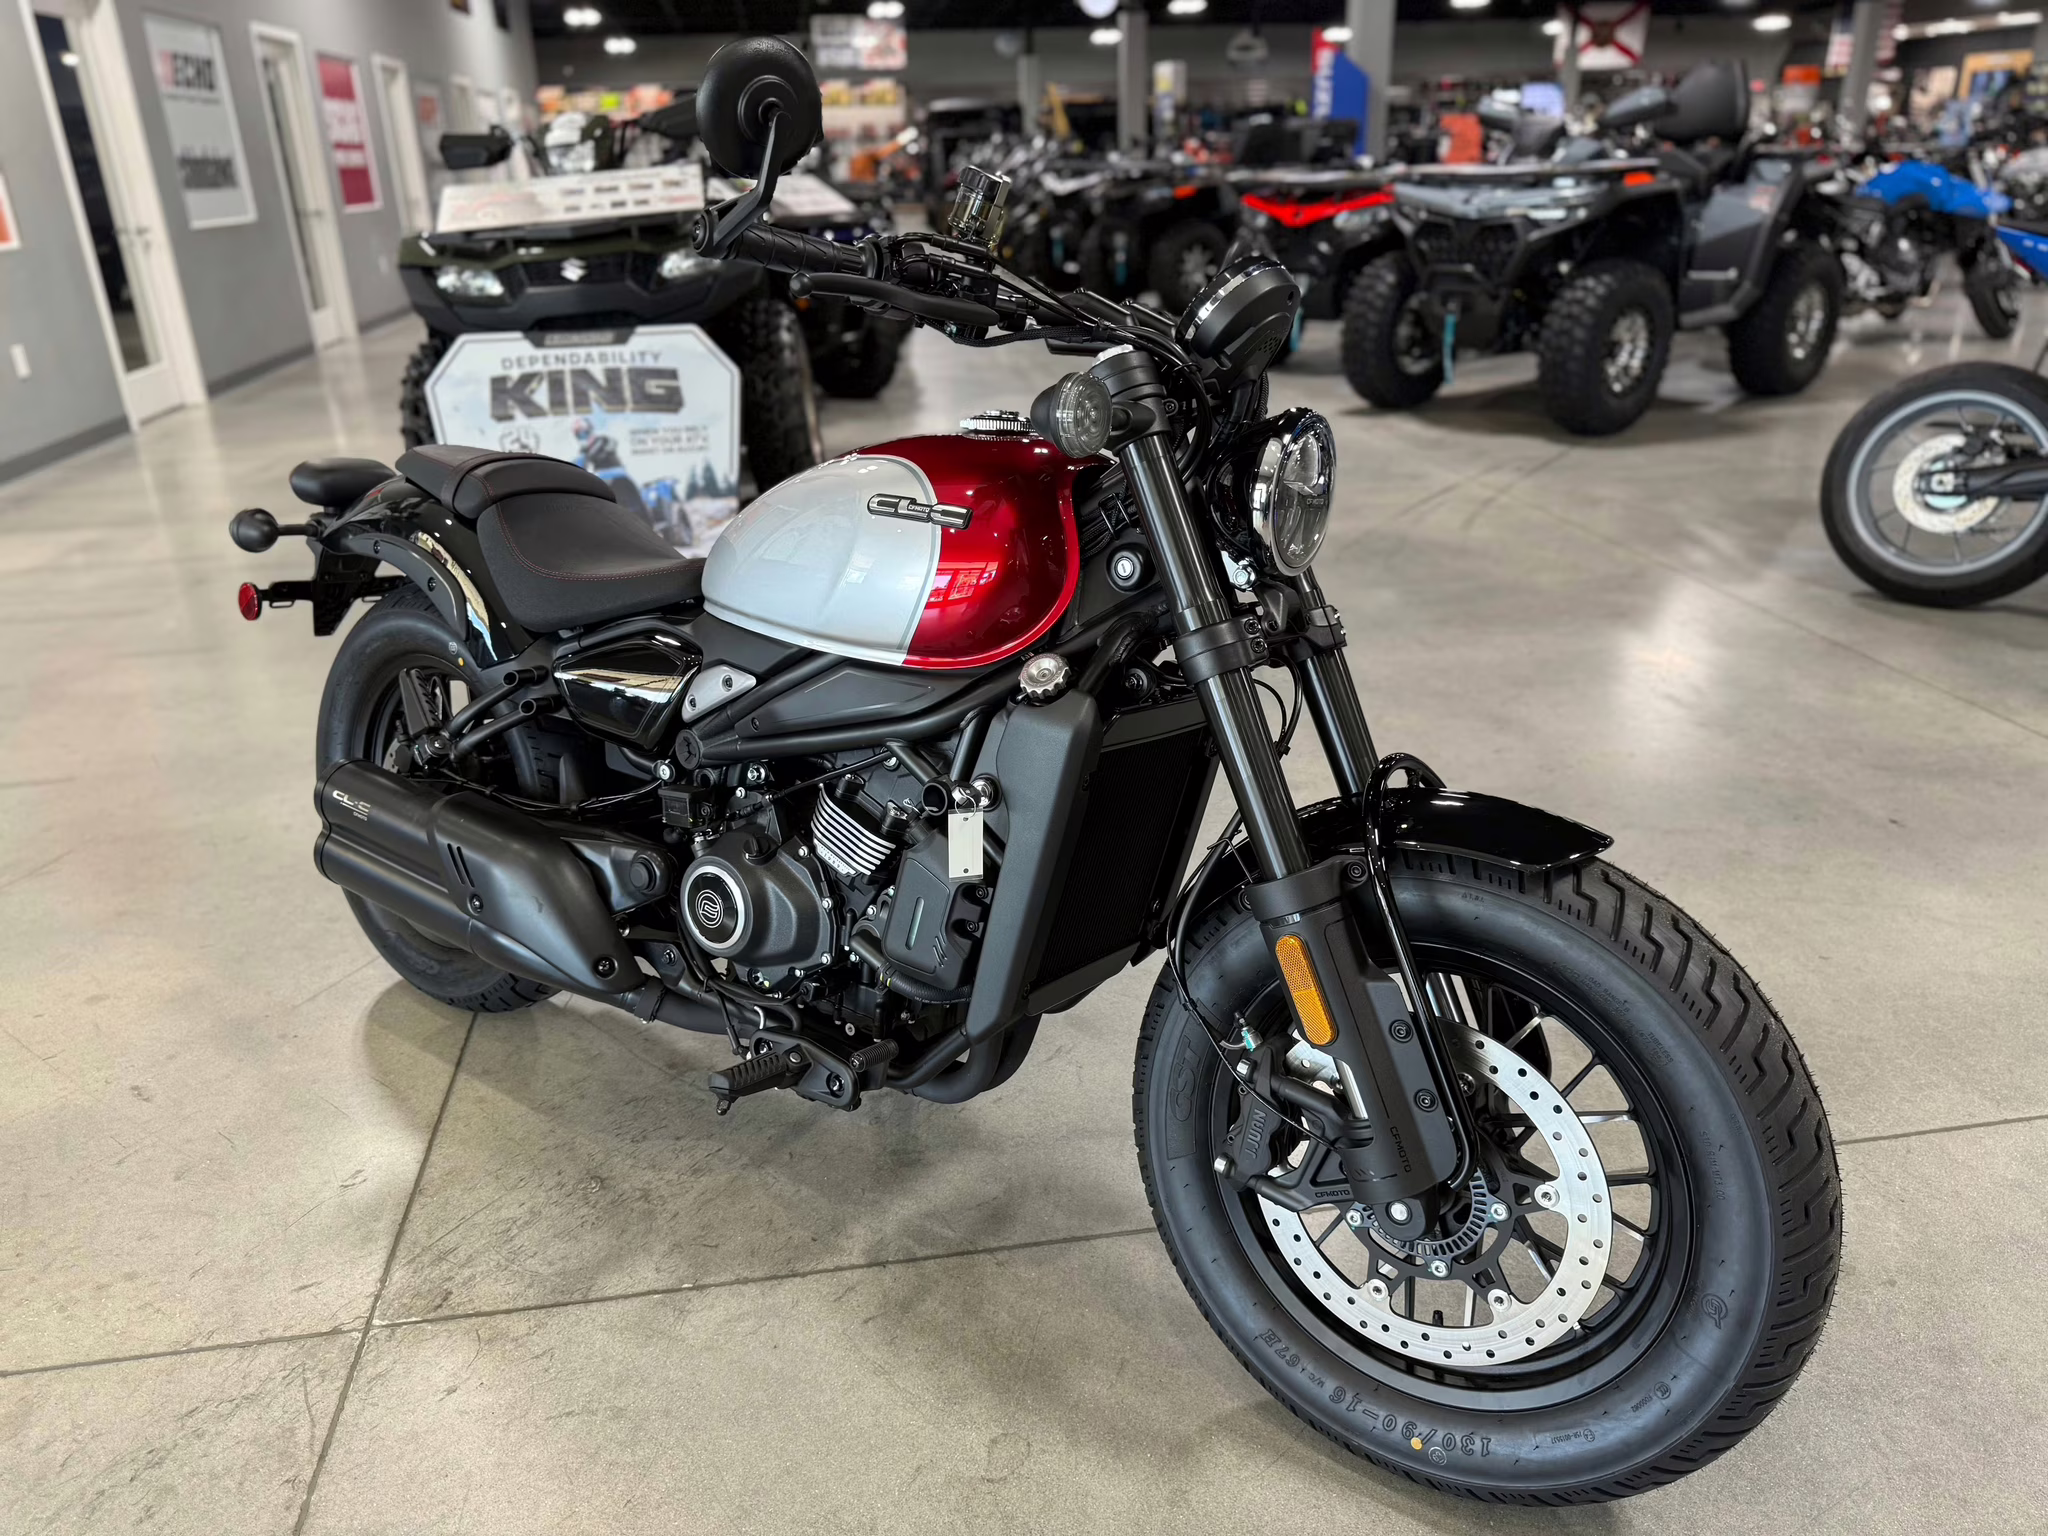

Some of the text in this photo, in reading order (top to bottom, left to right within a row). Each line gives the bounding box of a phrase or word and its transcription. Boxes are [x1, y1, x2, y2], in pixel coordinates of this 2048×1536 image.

[500, 351, 663, 371] DEPENDABILITY
[490, 366, 685, 424] KING
[1169, 1034, 1201, 1122] CST
[1389, 1126, 1412, 1173] CFMOTO
[1314, 1189, 1351, 1198] CFMOTO
[1329, 1385, 1492, 1457] 130/90-16
